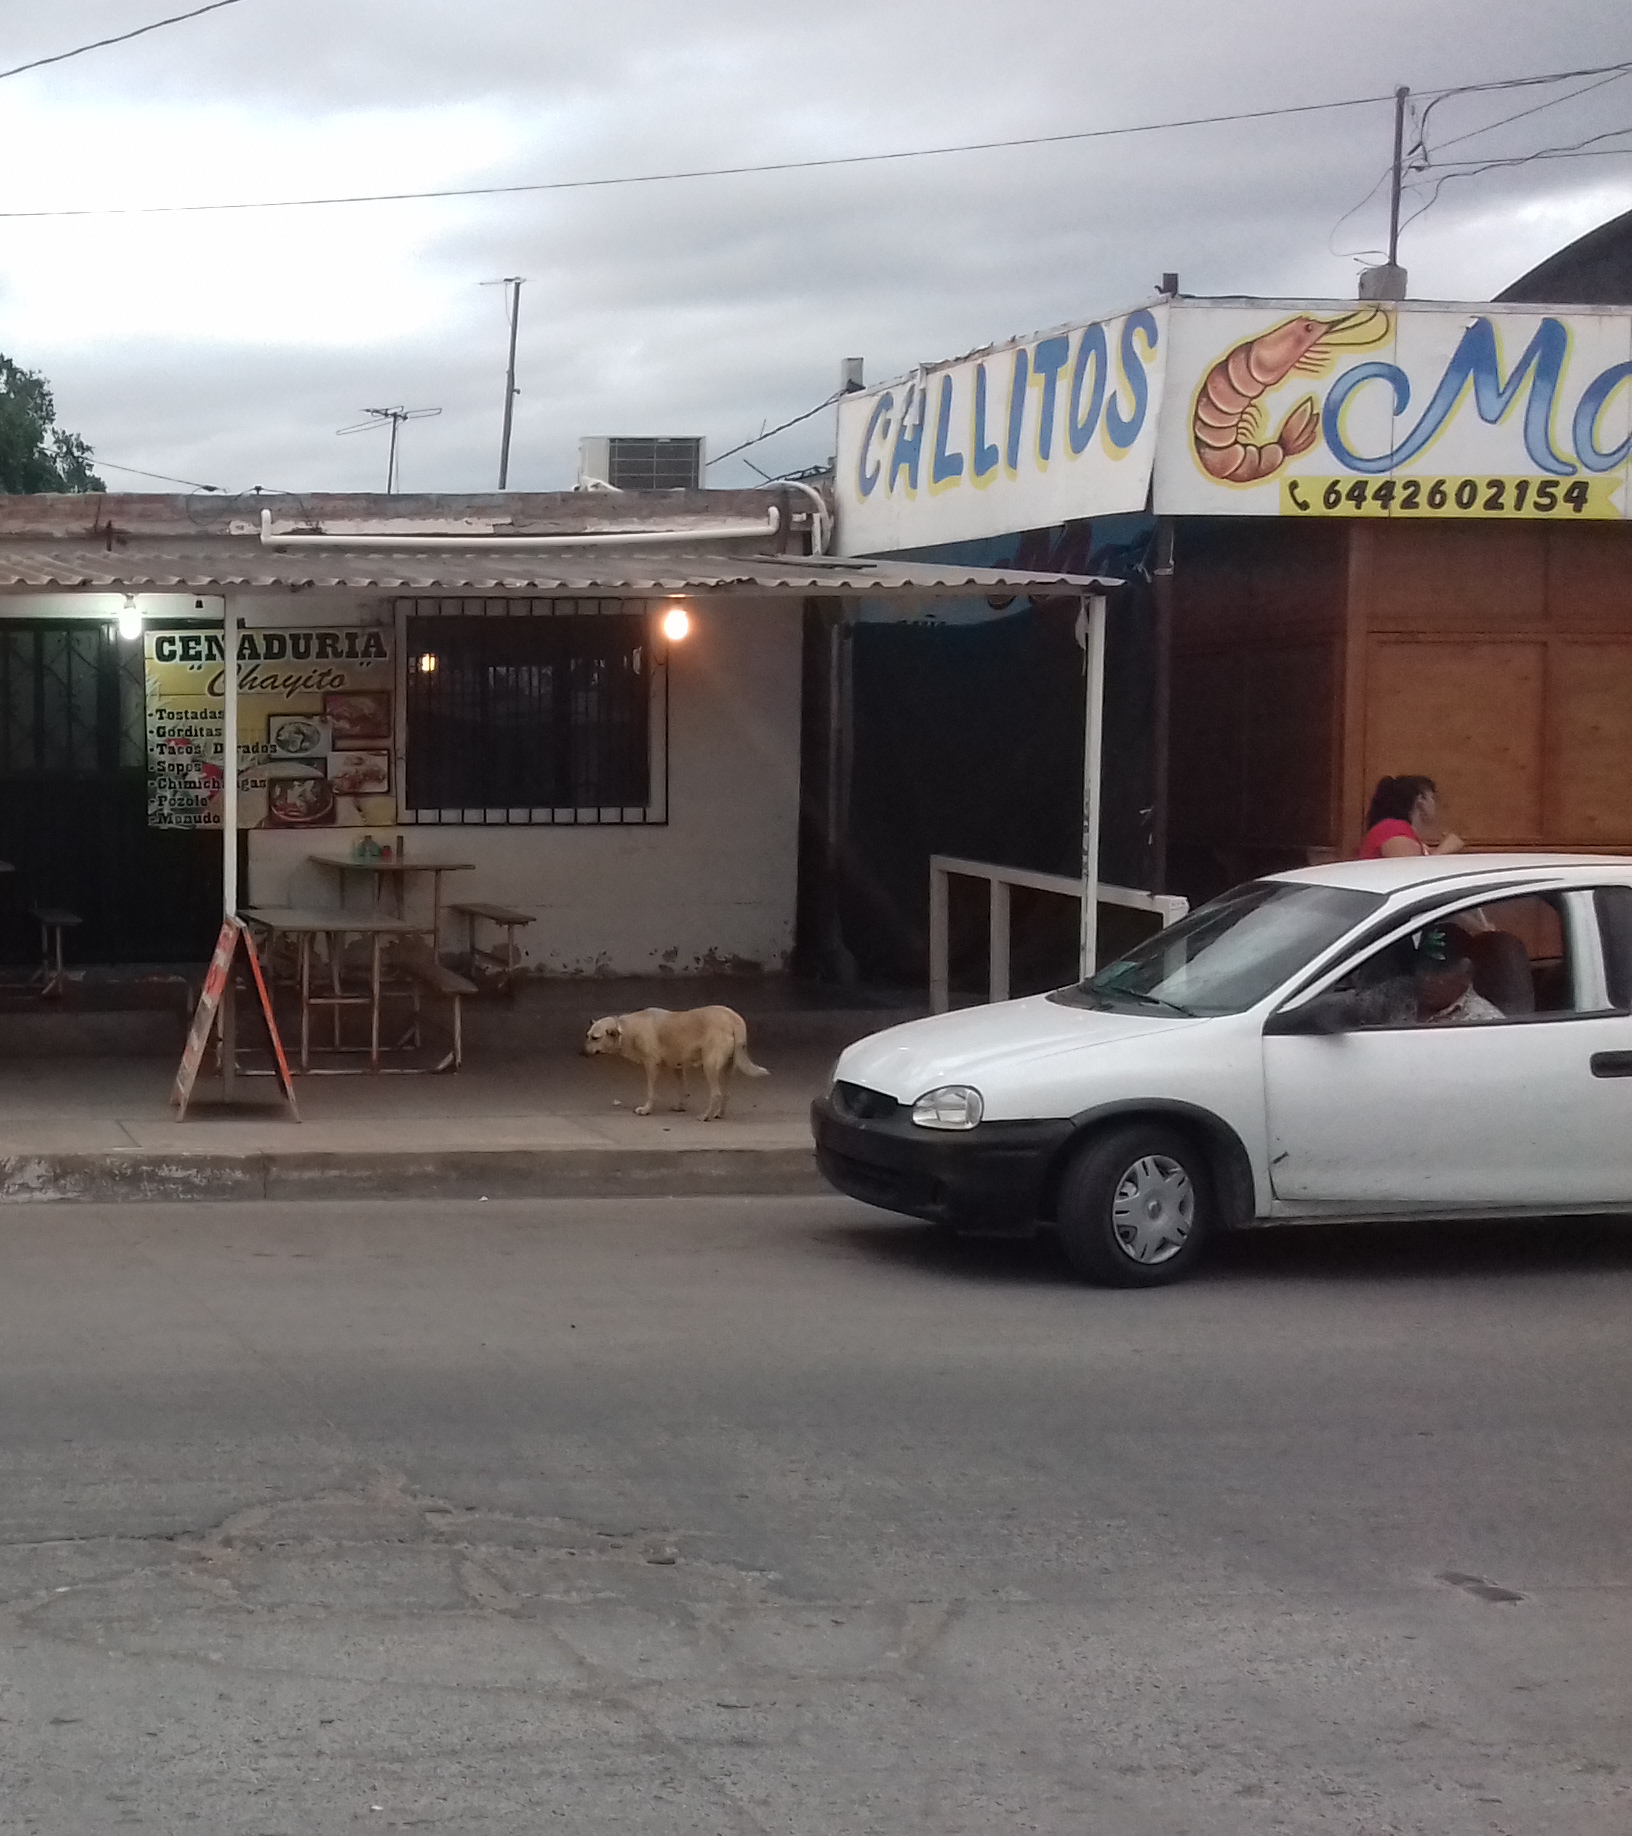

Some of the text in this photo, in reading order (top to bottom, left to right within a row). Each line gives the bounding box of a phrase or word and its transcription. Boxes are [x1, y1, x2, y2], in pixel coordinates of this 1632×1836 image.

[858, 309, 1158, 501] CALLITOS
[1322, 479, 1590, 512] 6442602154
[155, 631, 388, 662] CENADURIA
[156, 708, 225, 721] Tostadas
[156, 725, 222, 738] Gorditas
[156, 741, 277, 755] Tacos Drados
[157, 778, 267, 792] Chimichgas
